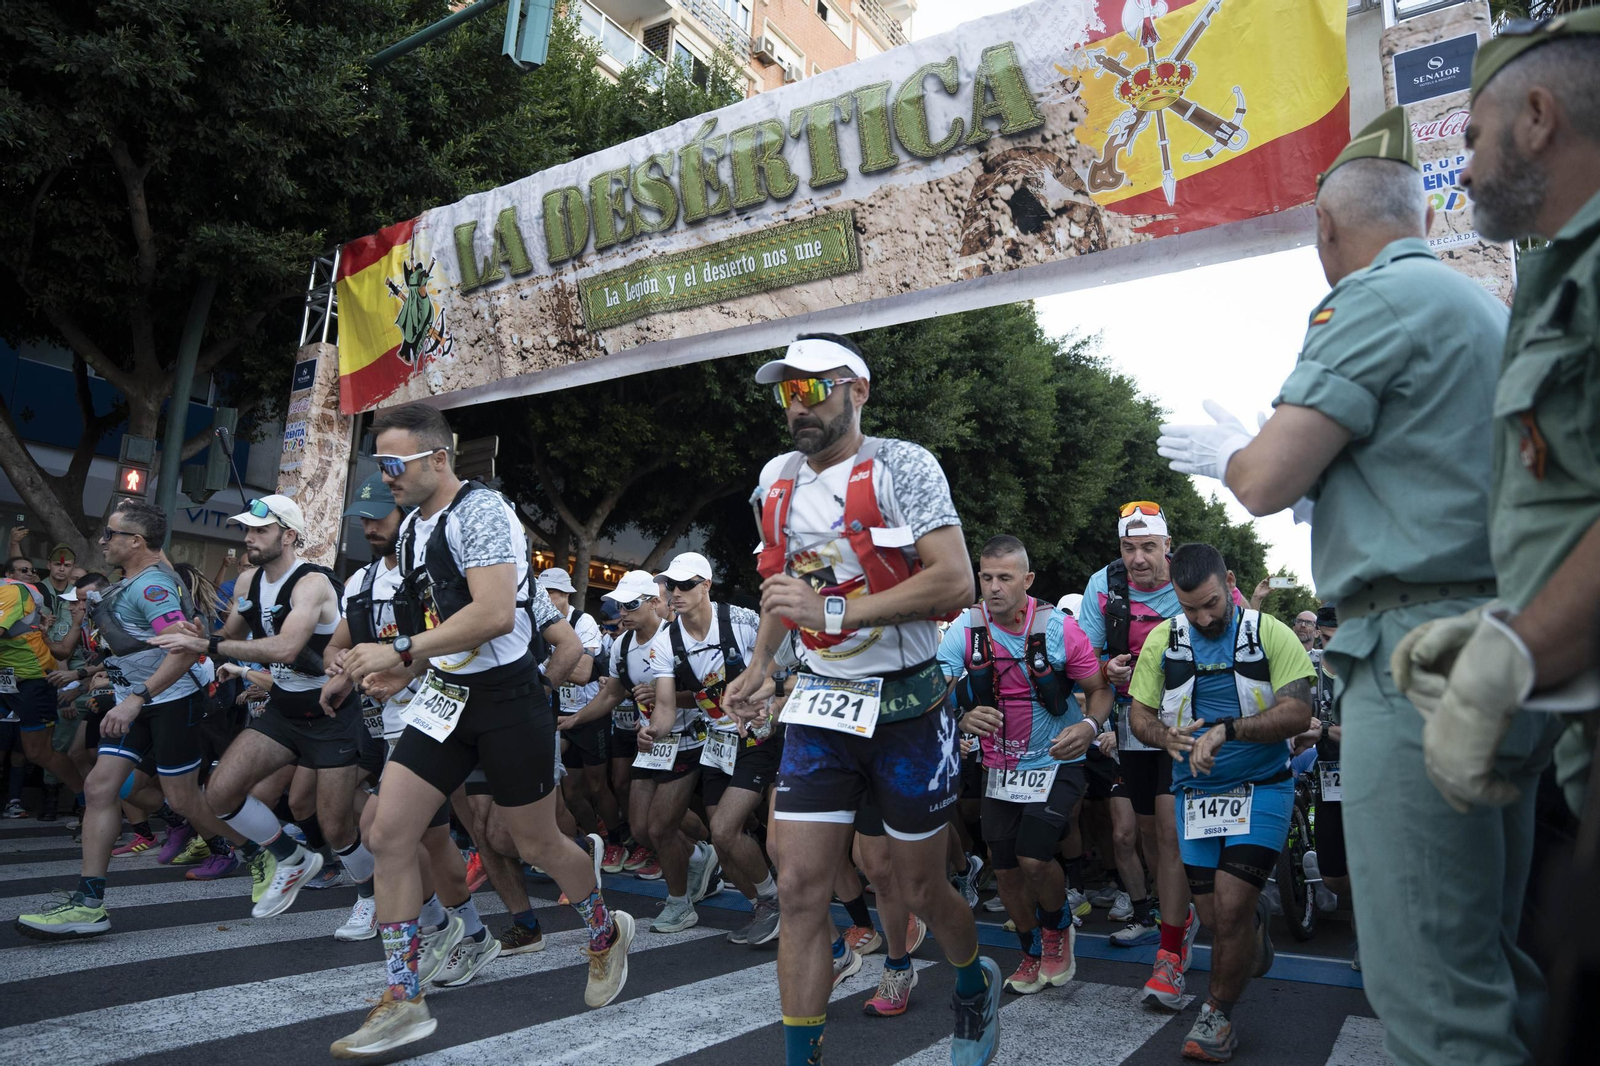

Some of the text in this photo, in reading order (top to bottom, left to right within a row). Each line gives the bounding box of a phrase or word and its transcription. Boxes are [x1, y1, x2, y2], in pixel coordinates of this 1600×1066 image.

[1413, 67, 1460, 85] SENATOR
[454, 40, 1047, 292] LA DESÉRTICA
[604, 240, 823, 308] La Legión y el desierto nos une
[285, 428, 305, 439] RENTA
[424, 693, 458, 722] 4602
[807, 692, 865, 722] 1521
[412, 716, 430, 730] asisa
[1007, 769, 1047, 788] 2102
[929, 803, 939, 812] LA
[1199, 798, 1242, 818] 1470
[1204, 827, 1222, 835] asisa
